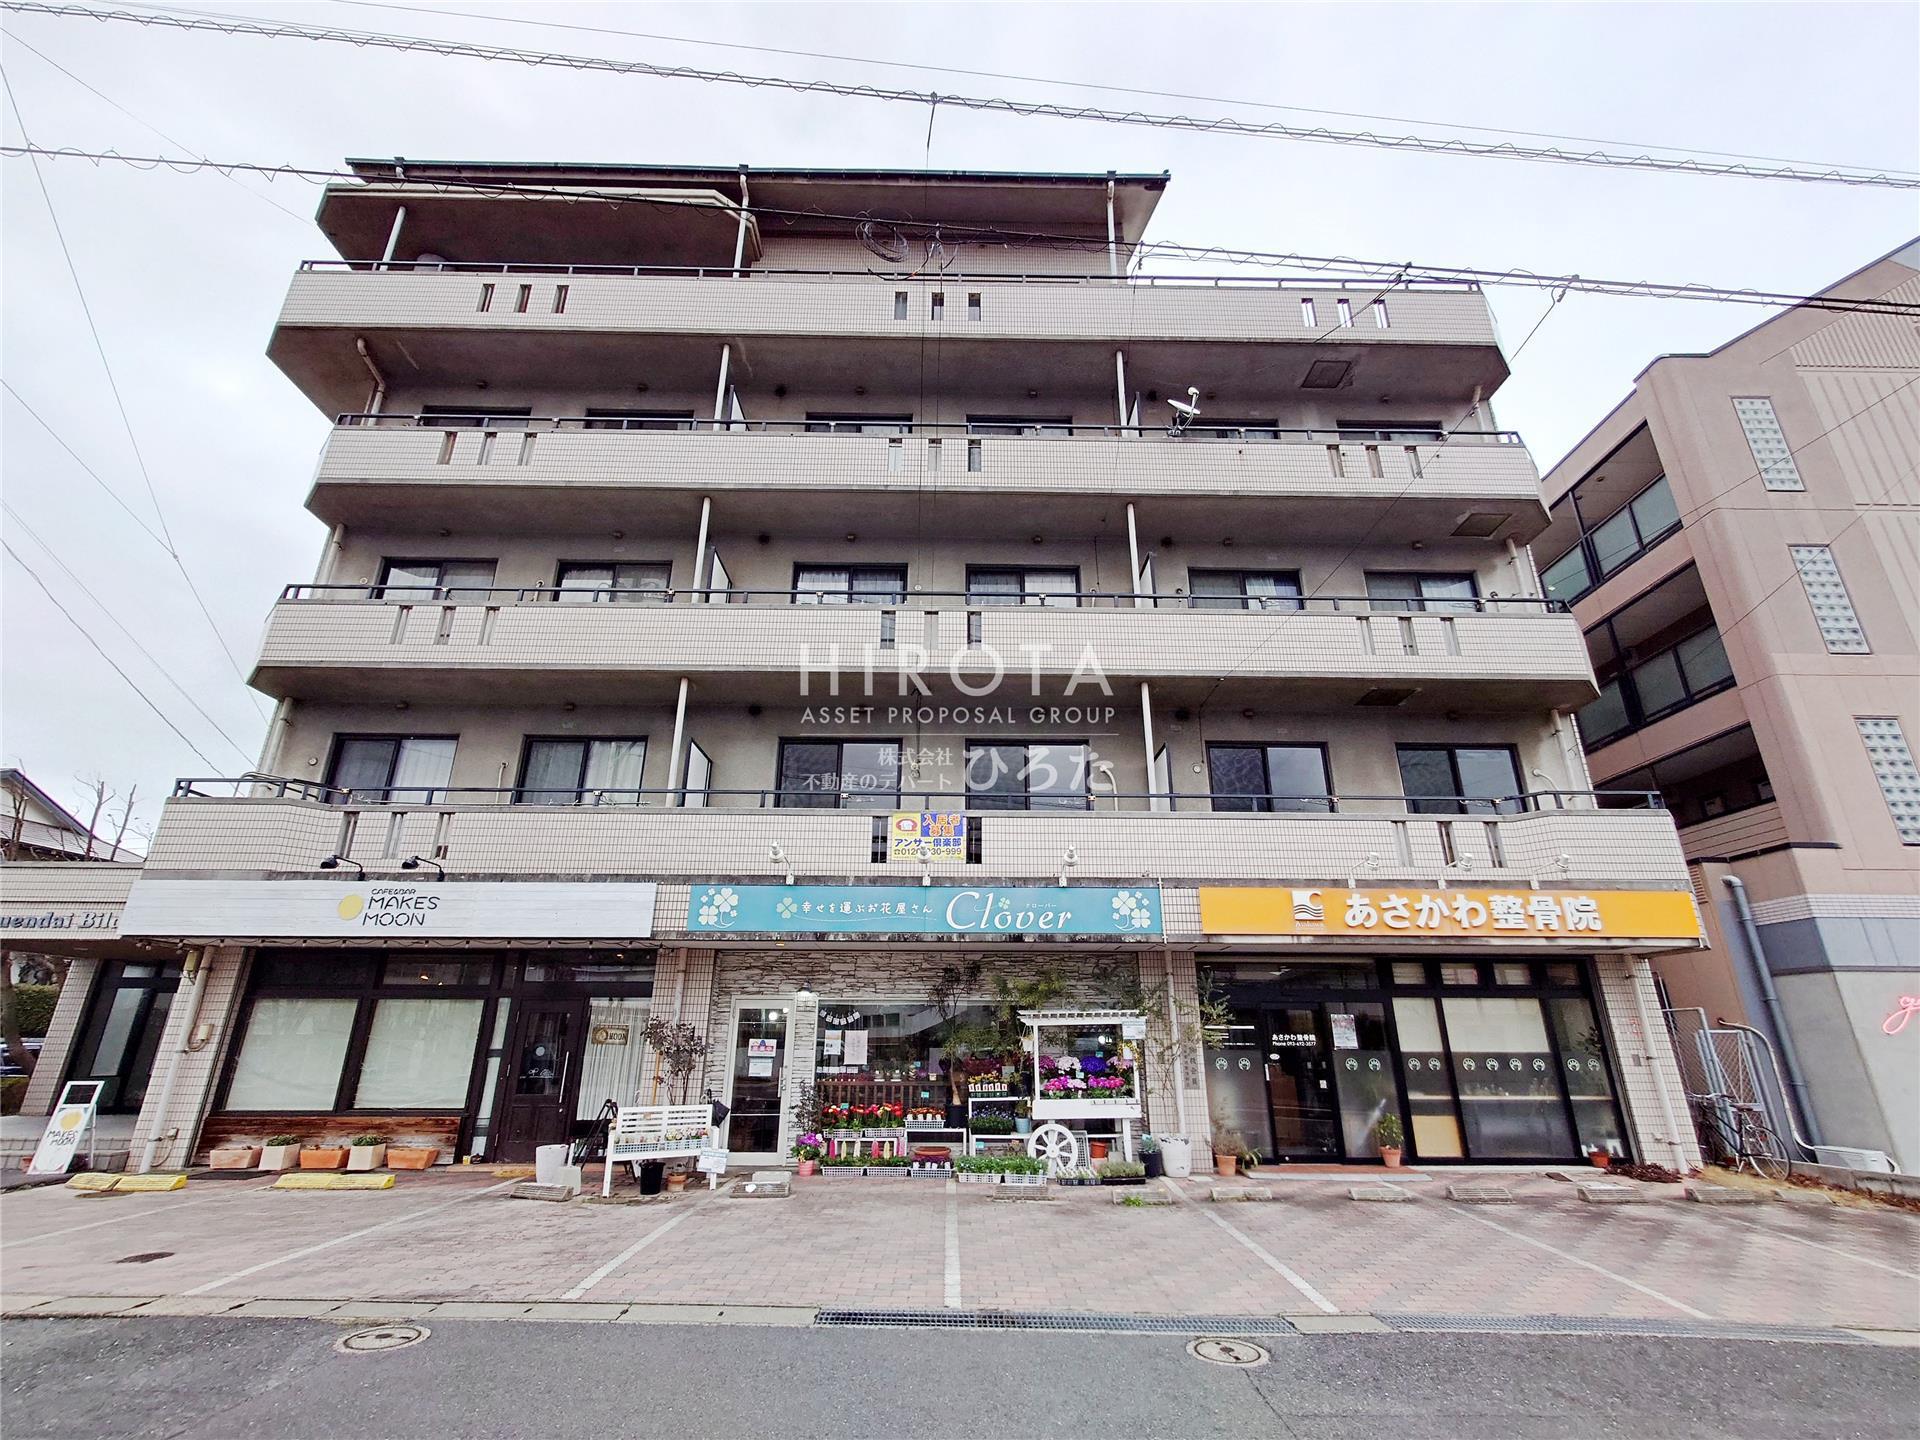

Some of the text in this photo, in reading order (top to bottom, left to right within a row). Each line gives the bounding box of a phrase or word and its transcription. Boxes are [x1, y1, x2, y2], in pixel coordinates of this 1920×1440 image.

[894, 838, 962, 847] アンサー倶楽部
[368, 896, 441, 910] MAKES
[801, 900, 934, 916] 幸せを運ぶお花屋さん
[945, 891, 1072, 930] Clover
[362, 912, 426, 926] MOON
[1343, 892, 1603, 931] あさかわ整骨院
